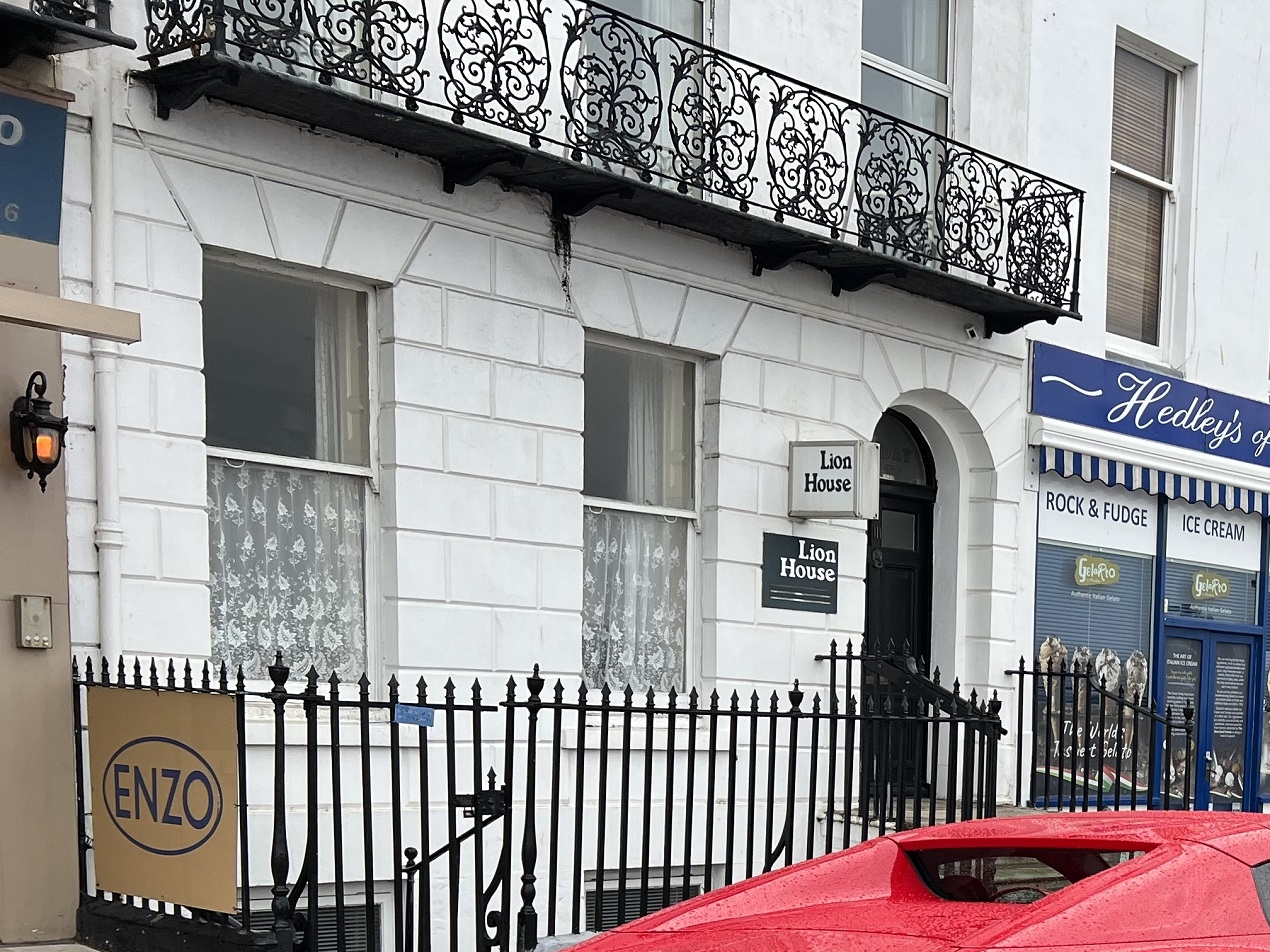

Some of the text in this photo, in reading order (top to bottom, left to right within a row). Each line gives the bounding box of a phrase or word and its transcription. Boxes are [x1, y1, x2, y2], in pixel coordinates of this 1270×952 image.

[1107, 372, 1242, 449] Hedley's
[820, 450, 852, 469] Lion
[804, 473, 851, 492] House
[1046, 492, 1148, 527] ROCK & FUDGE
[1183, 514, 1245, 541] ICE CREAM
[798, 540, 837, 564] Lion
[780, 557, 836, 582] House
[1070, 590, 1092, 599] Authentic
[1092, 593, 1106, 601] Italian
[114, 763, 214, 830] ENZO
